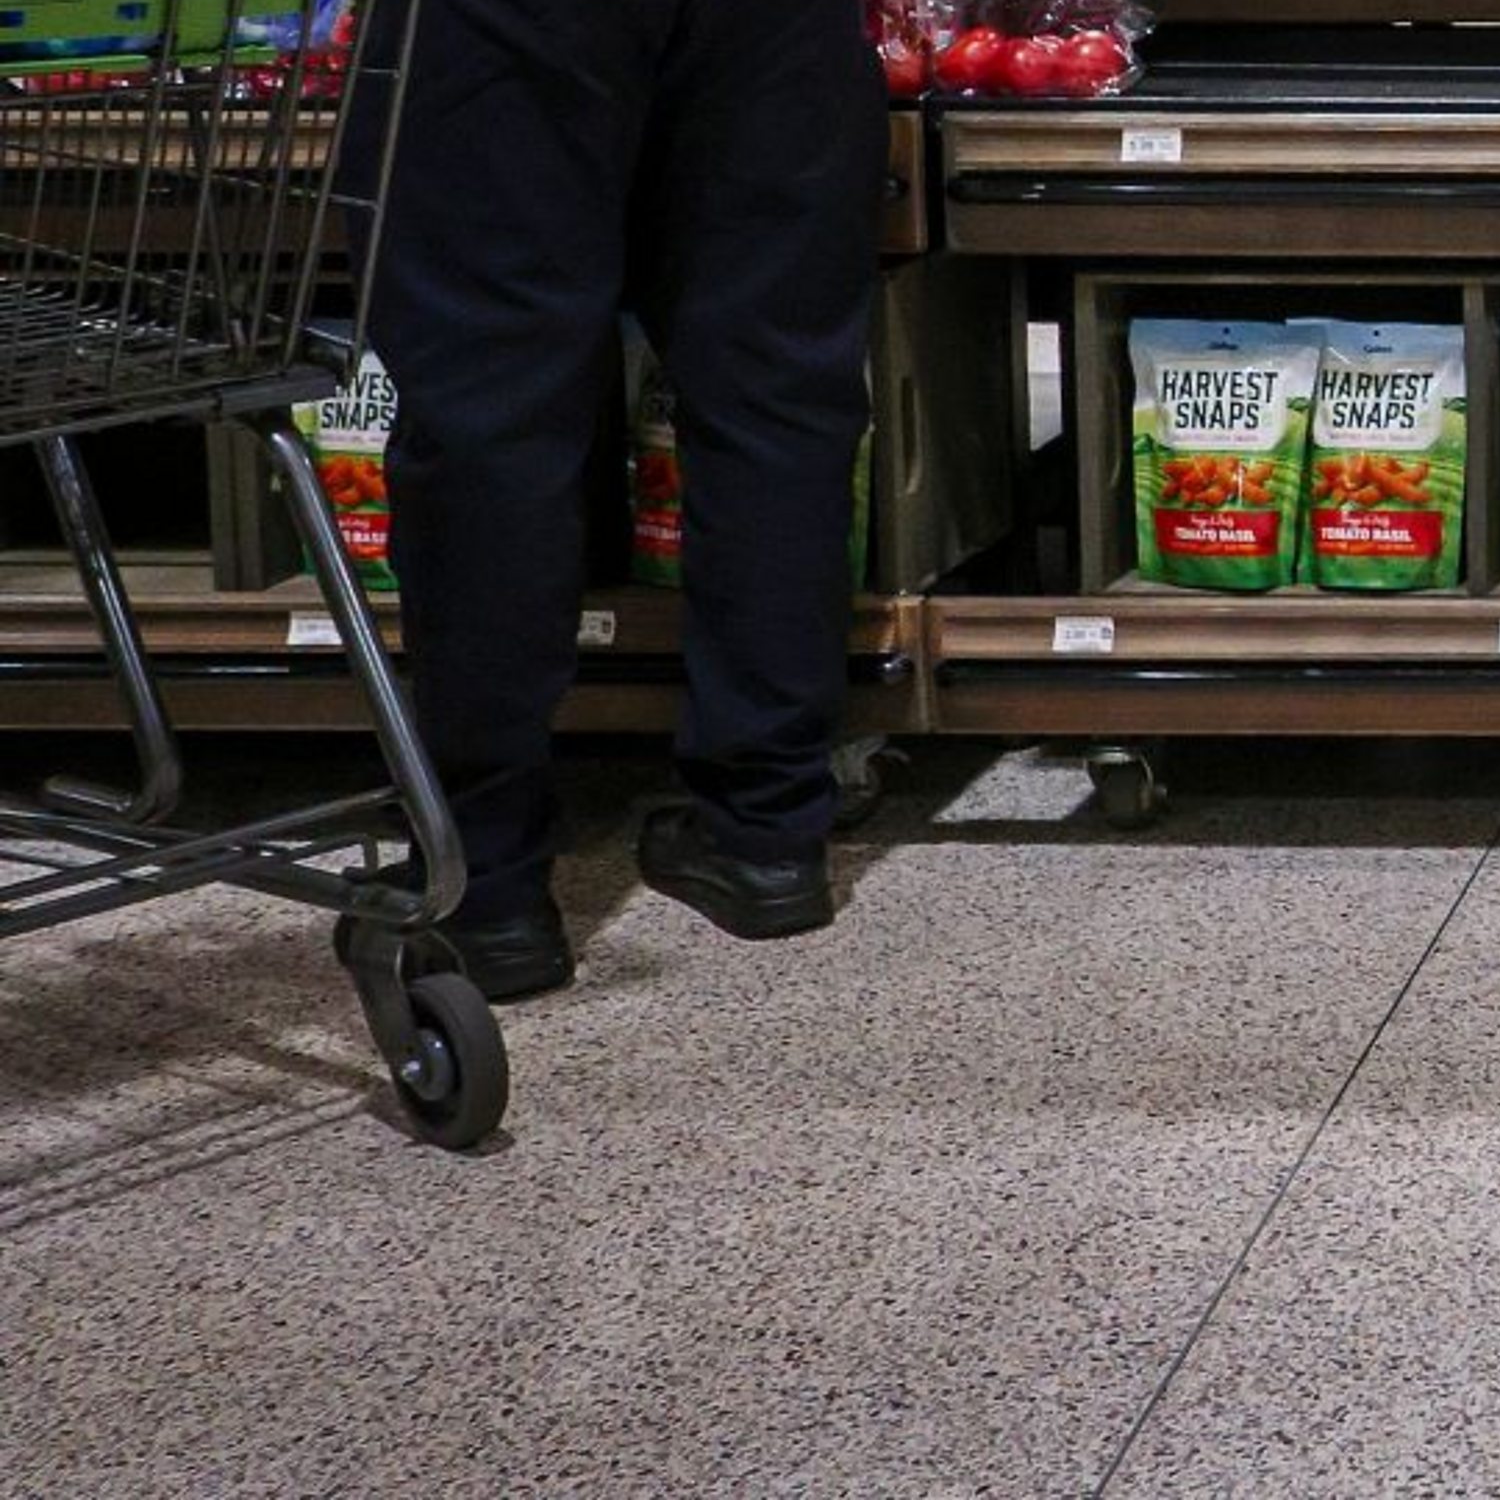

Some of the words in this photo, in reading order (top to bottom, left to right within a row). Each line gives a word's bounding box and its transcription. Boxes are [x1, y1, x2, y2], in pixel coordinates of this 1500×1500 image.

[1162, 370, 1279, 403] HARVEST
[1321, 369, 1434, 402] HARVEST
[321, 402, 397, 432] SNAPS
[1174, 400, 1260, 429] SNAPS
[1332, 401, 1416, 429] SNAPS
